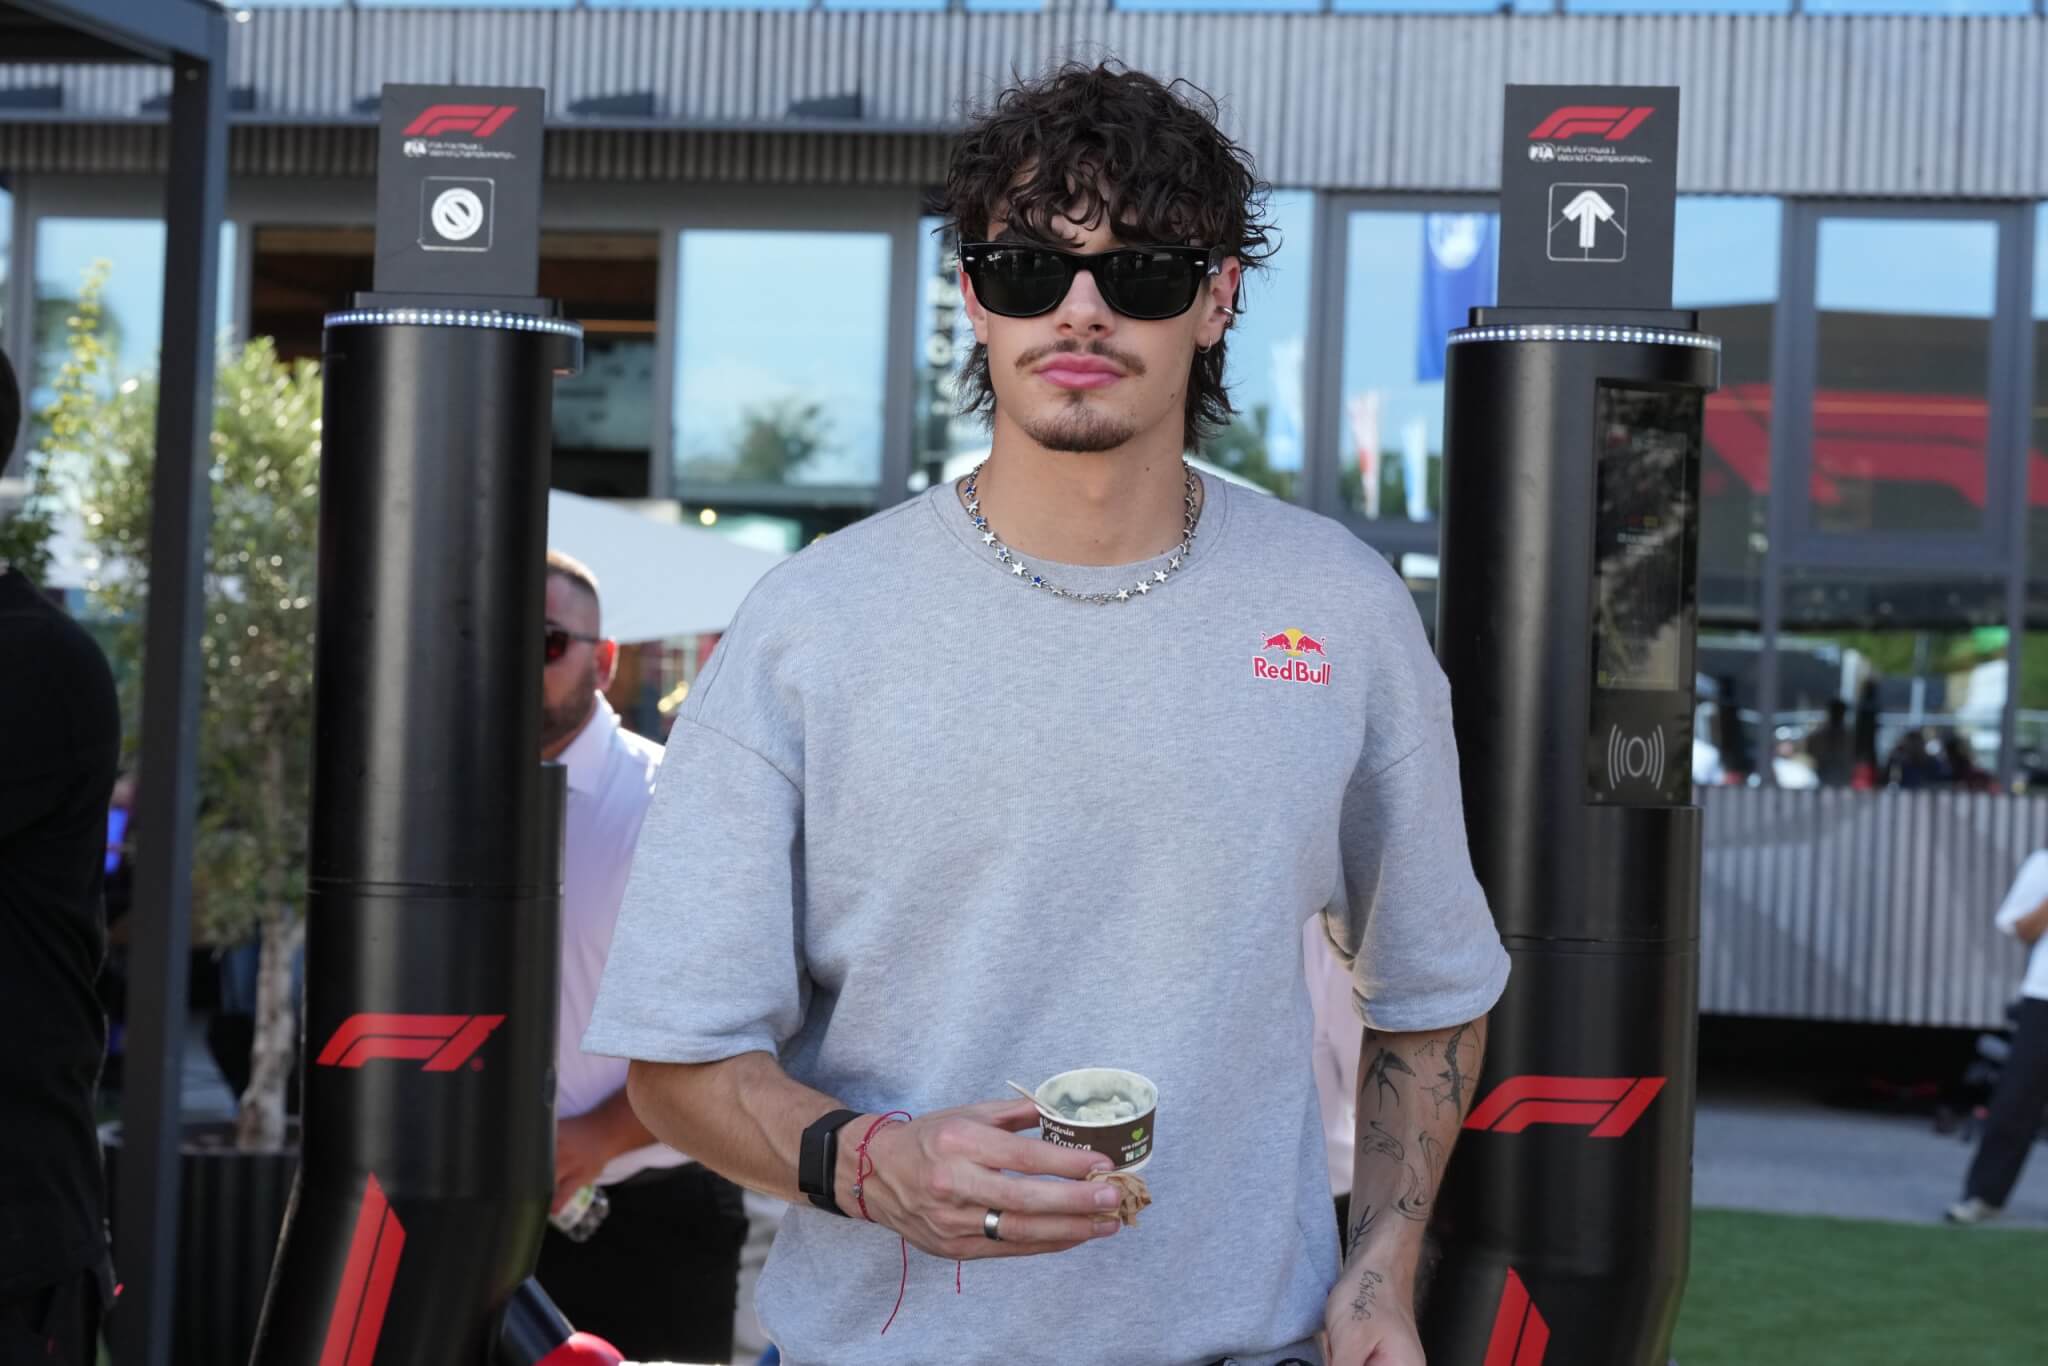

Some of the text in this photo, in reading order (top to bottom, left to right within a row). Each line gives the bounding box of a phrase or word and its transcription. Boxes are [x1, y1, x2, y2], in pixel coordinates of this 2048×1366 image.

[1529, 145, 1555, 161] FIA
[1252, 655, 1332, 687] Red Bull
